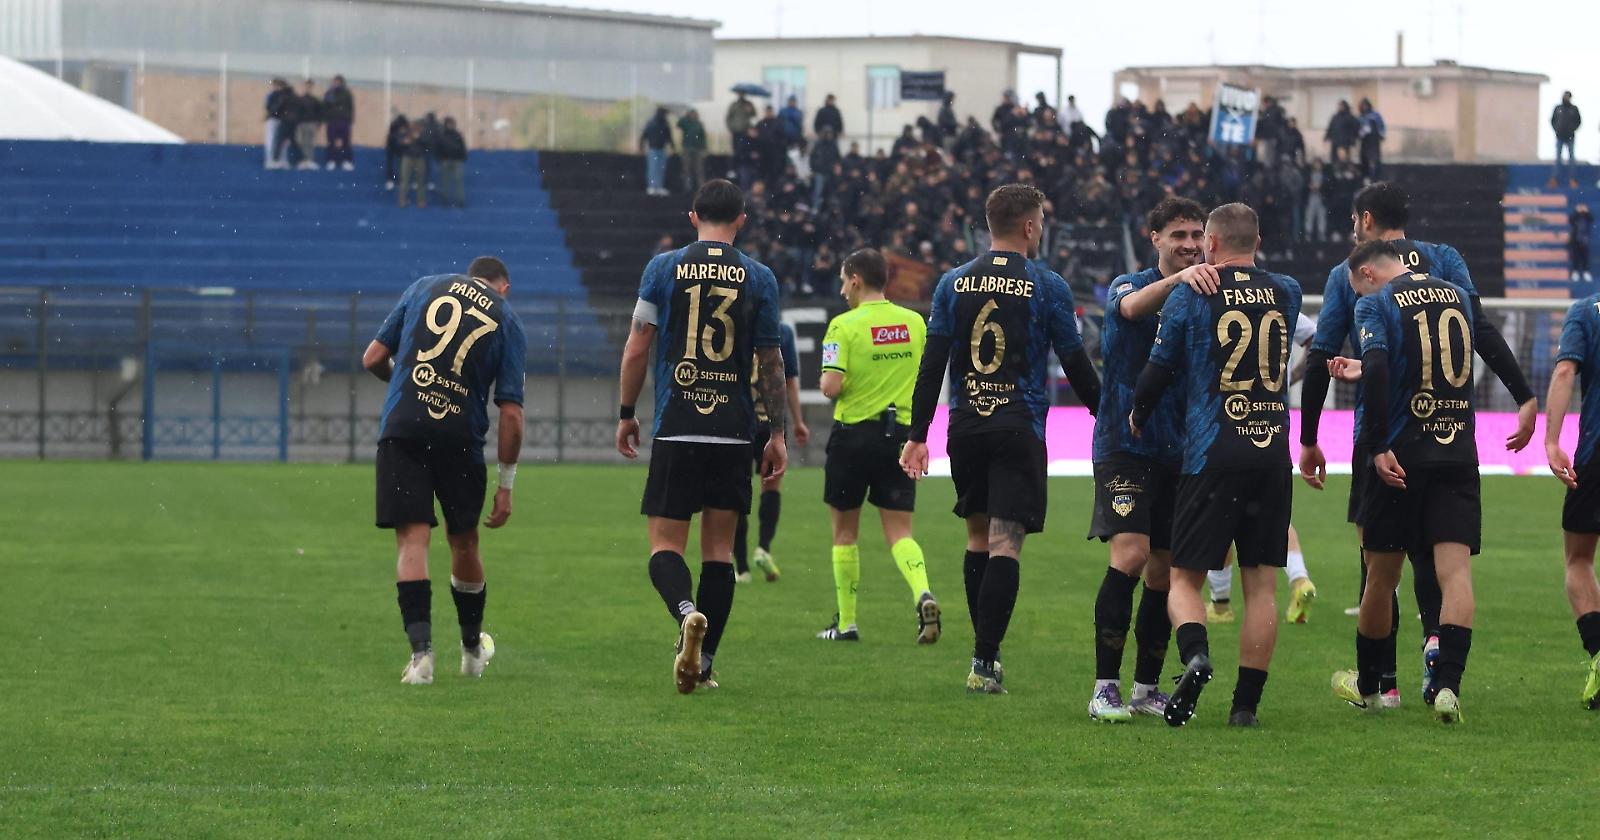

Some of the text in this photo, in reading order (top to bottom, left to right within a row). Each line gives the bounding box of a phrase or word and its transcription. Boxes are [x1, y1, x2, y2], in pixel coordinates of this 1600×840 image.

[1398, 250, 1420, 268] LO
[676, 263, 746, 283] MARENCO
[448, 282, 494, 310] PARIGI
[953, 275, 1035, 298] CALABRESE
[1222, 287, 1276, 306] FASAN
[1393, 287, 1461, 308] RICCARDI
[683, 284, 738, 362] 13
[416, 295, 499, 376] 97
[872, 327, 909, 342] Lete
[971, 298, 1006, 375] 6
[872, 351, 913, 361] GIVOVA
[1217, 310, 1288, 392] 20
[1413, 308, 1471, 390] 10
[700, 370, 738, 382] SISTEMI
[681, 390, 729, 404] THAILAND
[979, 381, 1016, 393] SISTEMI
[416, 391, 461, 414] THAILAND
